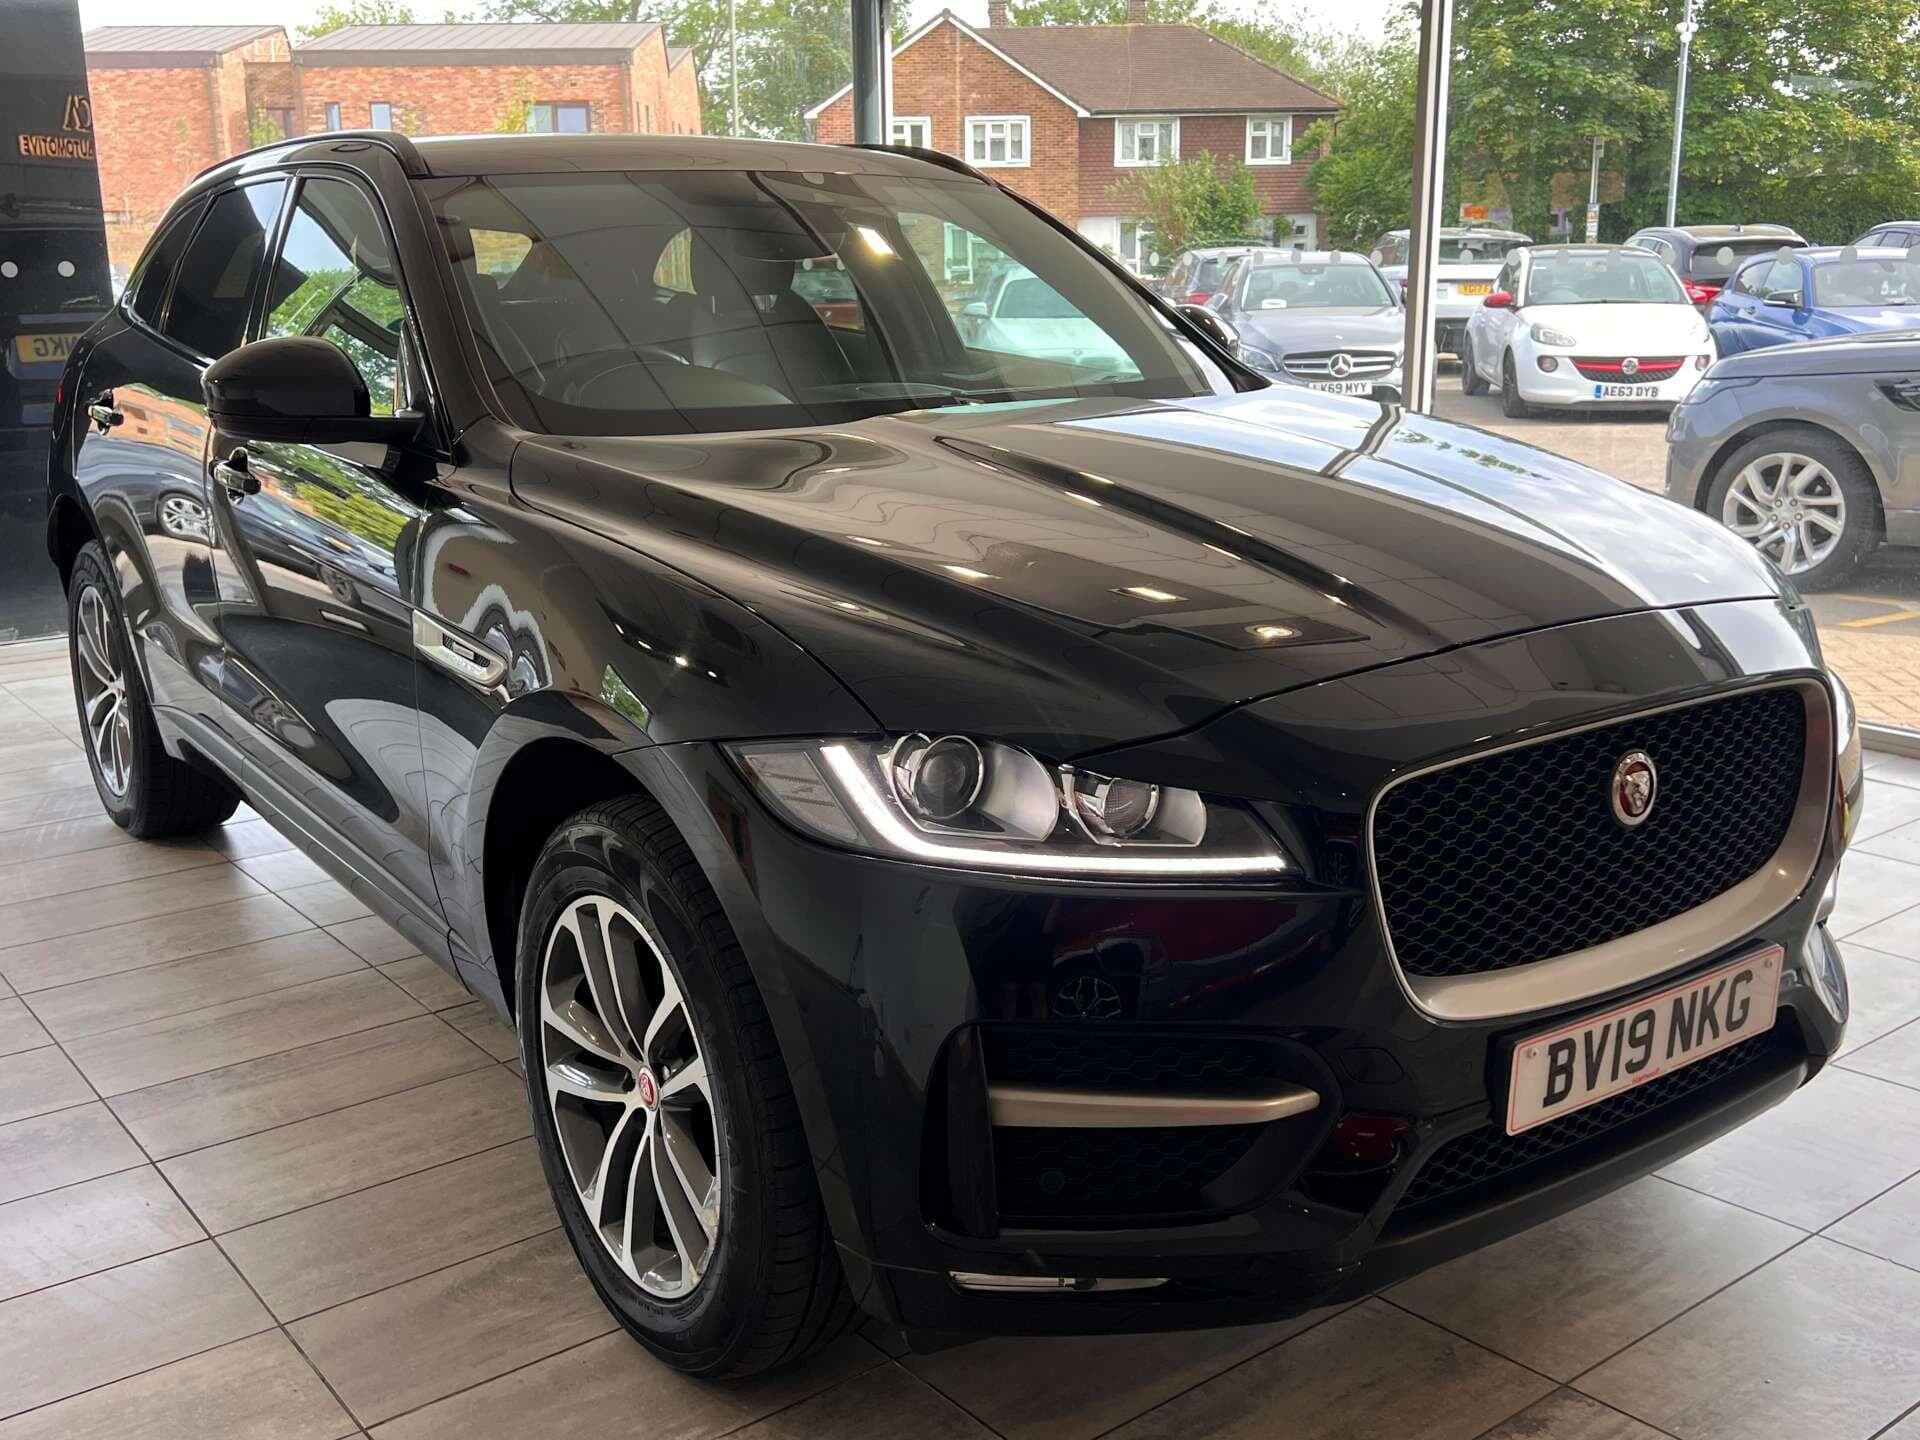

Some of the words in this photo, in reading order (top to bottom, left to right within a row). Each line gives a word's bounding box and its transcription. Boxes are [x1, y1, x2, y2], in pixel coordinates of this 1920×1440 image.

[1345, 382, 1368, 394] MYY
[1604, 386, 1633, 397] AE63
[1636, 386, 1659, 397] DYB
[1542, 1008, 1656, 1109] BV19
[1666, 969, 1753, 1060] NKG
